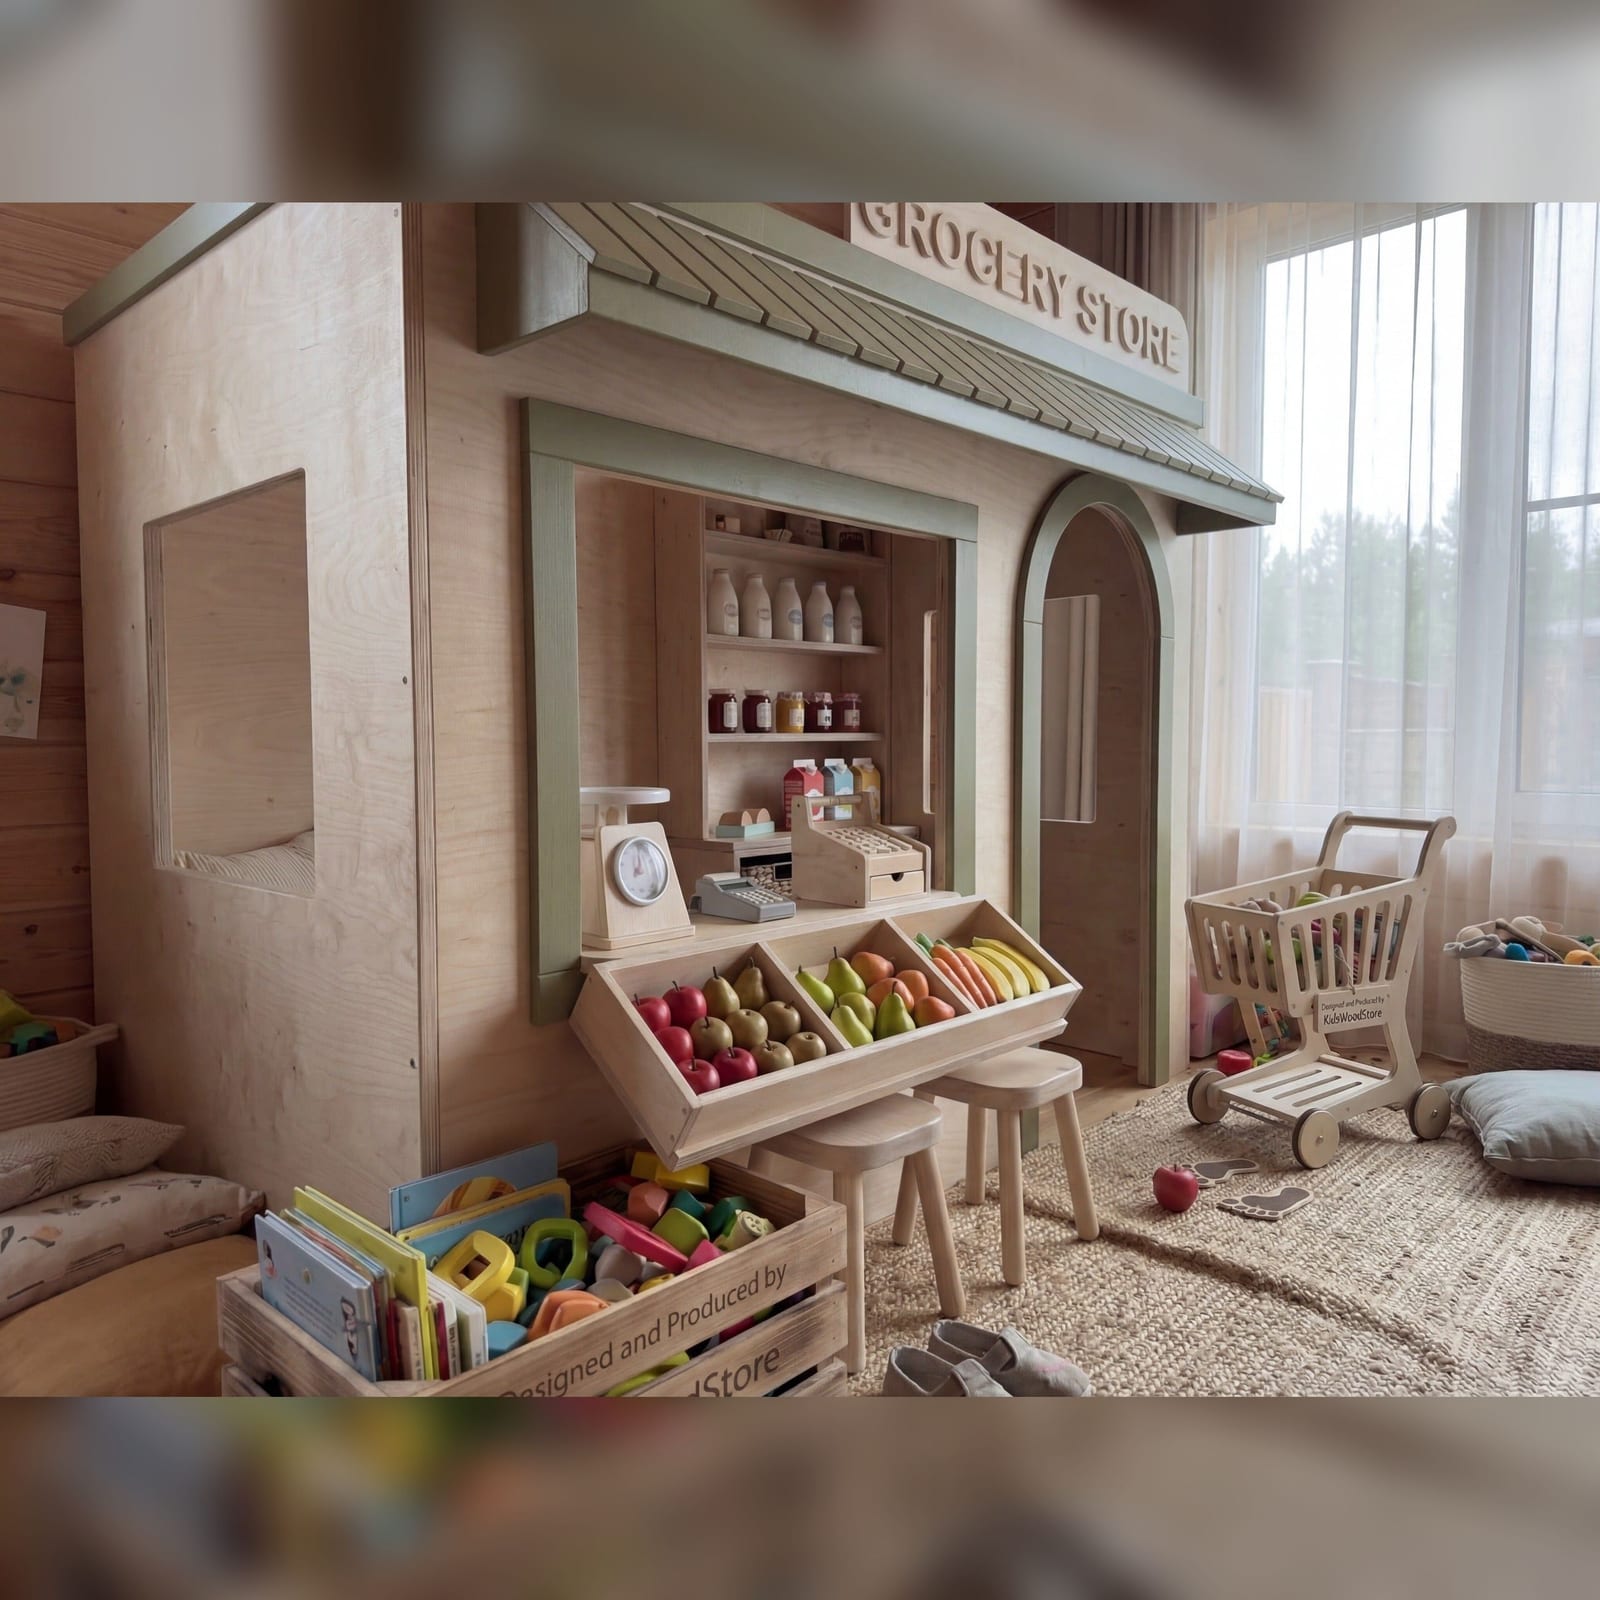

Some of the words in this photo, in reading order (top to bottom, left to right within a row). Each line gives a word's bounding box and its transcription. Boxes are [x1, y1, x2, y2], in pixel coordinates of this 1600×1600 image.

[858, 202, 1070, 318] GROCERY
[1077, 285, 1181, 373] STORE
[1323, 1008, 1383, 1025] KidsWoodStore
[498, 1342, 614, 1398] signed
[620, 1318, 661, 1360] and
[667, 1276, 759, 1336] Produced
[764, 1263, 788, 1290] by
